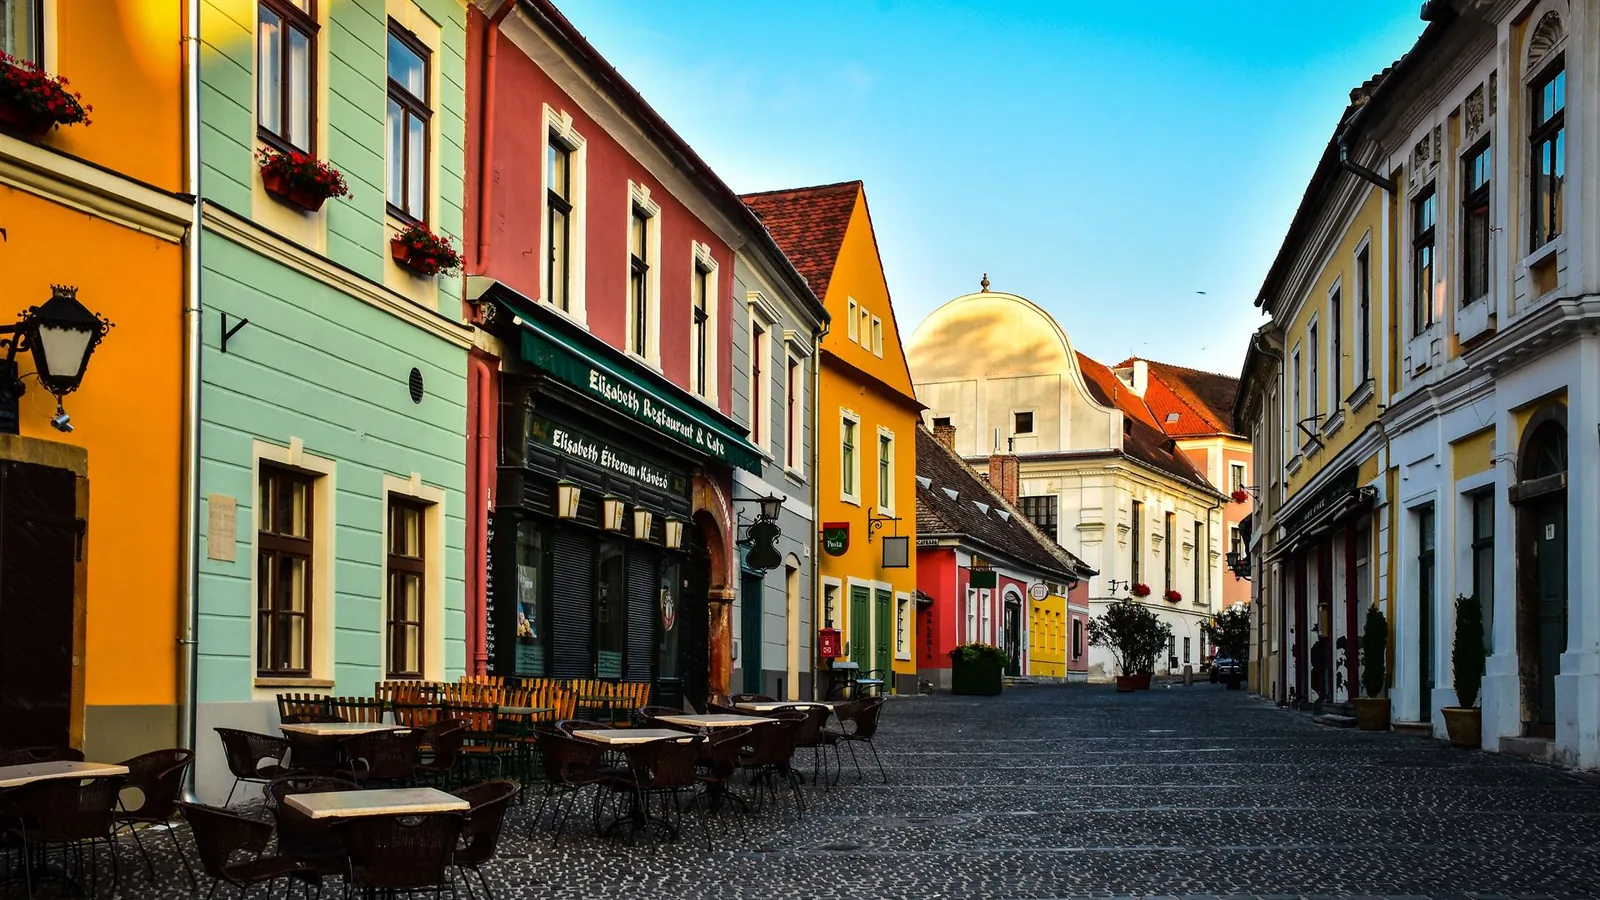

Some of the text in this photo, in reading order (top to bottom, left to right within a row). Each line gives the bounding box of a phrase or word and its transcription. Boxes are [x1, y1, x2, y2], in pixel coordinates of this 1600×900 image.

[589, 369, 725, 456] Elisabeth Restaurant & Cafe
[552, 429, 598, 463] Elisabeth
[600, 445, 636, 477] Étterem
[640, 465, 668, 489] Kávézó
